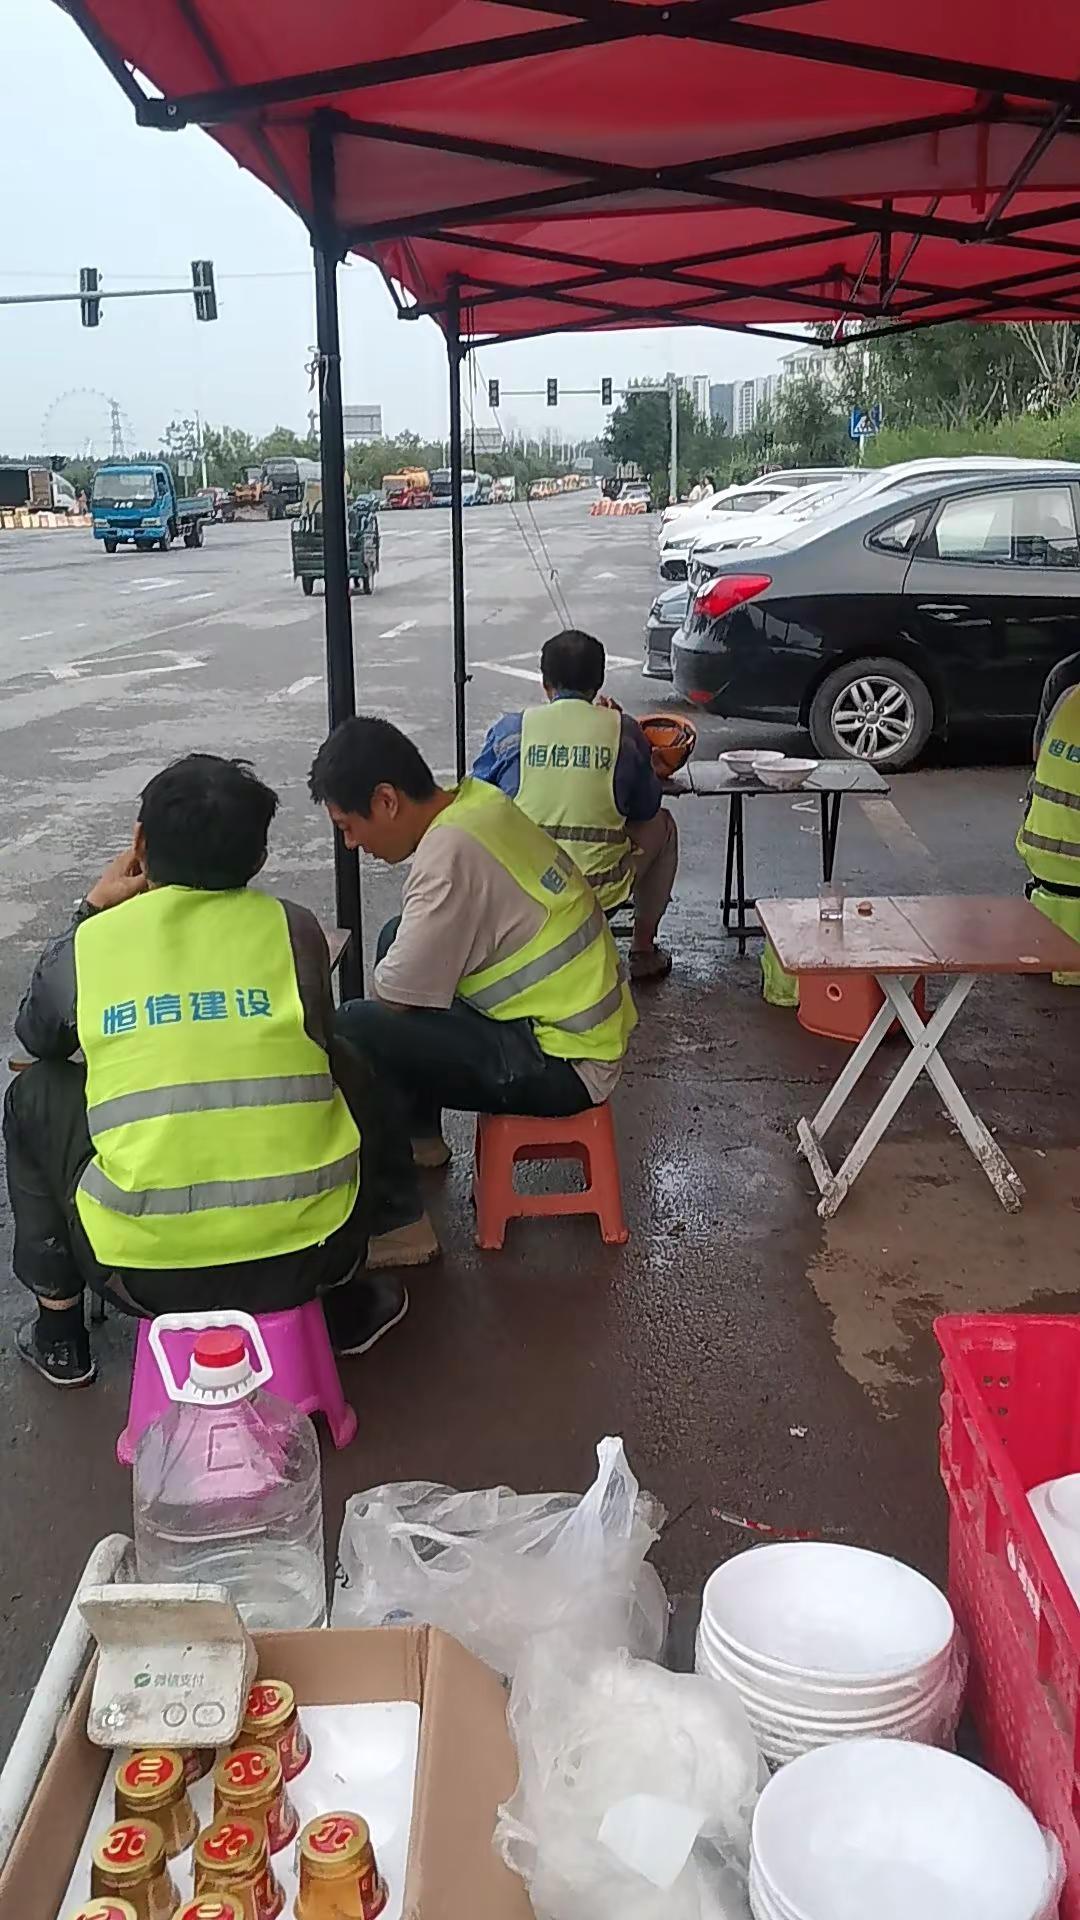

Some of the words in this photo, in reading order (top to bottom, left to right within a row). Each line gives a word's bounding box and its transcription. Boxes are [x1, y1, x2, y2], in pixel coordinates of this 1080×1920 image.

[526, 743, 612, 770] 恒信建设
[103, 988, 273, 1035] 恒信建设
